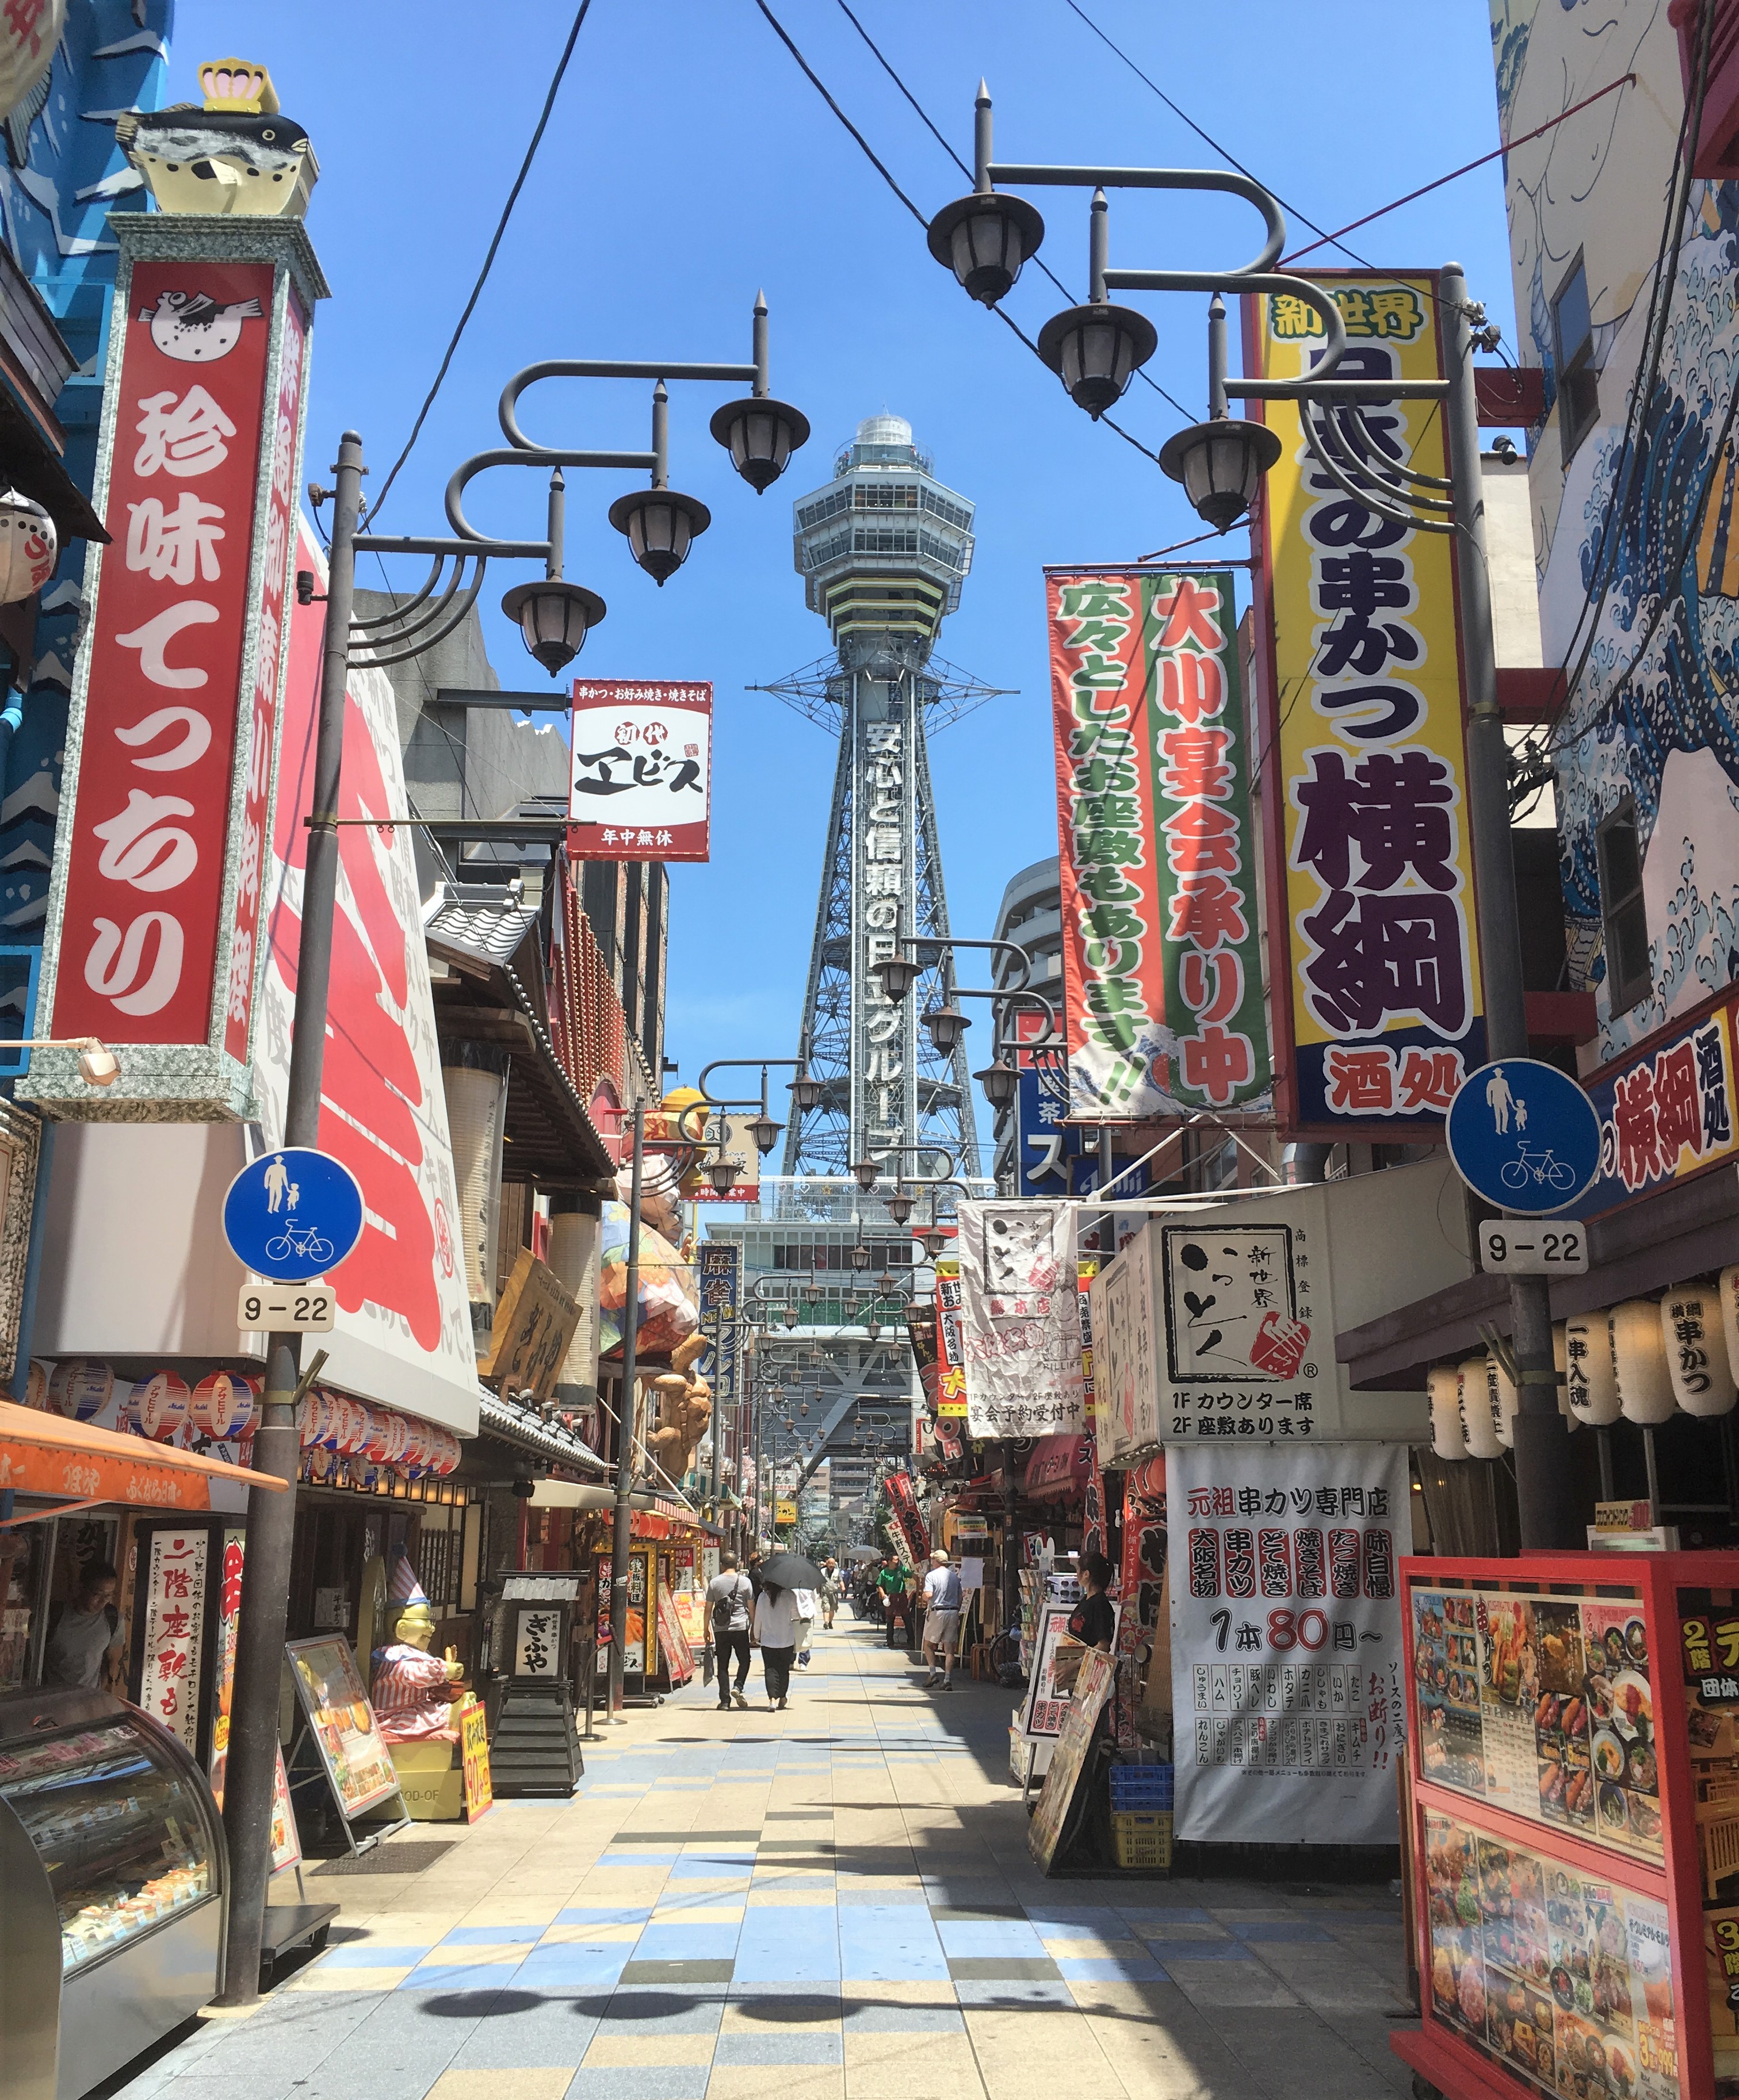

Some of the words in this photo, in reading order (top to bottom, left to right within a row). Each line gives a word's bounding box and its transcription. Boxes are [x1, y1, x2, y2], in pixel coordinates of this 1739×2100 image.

[1271, 289, 1422, 341] 新世界
[83, 384, 237, 1017] 珍味てっちり
[579, 684, 707, 702] 串かつ・お好み焼き・焼きそば
[614, 722, 668, 745] 初代
[575, 747, 703, 795] エビス
[601, 828, 672, 846] 年中無休
[1297, 751, 1458, 1033] 横綱
[1038, 1074, 1060, 1124] 喫茶
[1329, 1050, 1460, 1110] 酒処
[1696, 1026, 1730, 1149] 酒処
[1027, 1134, 1067, 1180] ス
[702, 1249, 732, 1306] 麻雀
[1247, 1245, 1276, 1309] 新世界
[1295, 1229, 1314, 1319] 商標登録
[1671, 1302, 1703, 1318] 横綱
[944, 1314, 959, 1363] 大阪名物
[1675, 1319, 1713, 1395] 串かつ
[1567, 1325, 1591, 1407] 一串入魂
[144, 1385, 159, 1424] アサヒビール
[216, 1387, 227, 1425] アサヒビール
[970, 1403, 1081, 1422] 宴会予約受付中
[1172, 1392, 1191, 1410] 1F
[1197, 1391, 1313, 1412] カウンター席
[1172, 1416, 1193, 1435] 2F
[1197, 1416, 1314, 1436] 座敷あります
[1187, 1486, 1389, 1517] 元祖串カツ専門店
[629, 1558, 645, 1603] 鉄板料理
[1191, 1530, 1217, 1597] 大阪名物
[1226, 1530, 1253, 1597] 串カツ
[1263, 1530, 1289, 1597] どて焼き
[1297, 1531, 1324, 1598] 焼きそば
[1331, 1531, 1358, 1598] たこ焼き
[1366, 1531, 1391, 1598] 味自慢
[524, 1615, 551, 1674] ぎふや
[1683, 1620, 1711, 1670] 2階
[1197, 1667, 1207, 1709] しゅうまい
[1214, 1678, 1225, 1701] ハム
[1232, 1668, 1242, 1709] チョリソー
[1250, 1669, 1262, 1708] 豚ヘレ
[1267, 1669, 1277, 1708] いわし
[1283, 1668, 1294, 1708] ホタテ
[1317, 1667, 1327, 1710] ししゃも
[1332, 1677, 1344, 1703] いか
[1350, 1676, 1360, 1703] たこ
[1700, 1678, 1739, 1697] 団体
[1198, 1720, 1209, 1763] れんこん
[1216, 1720, 1225, 1763] じゃがいも
[1336, 1722, 1347, 1764] おにぎり
[1351, 1722, 1361, 1762] キムチ
